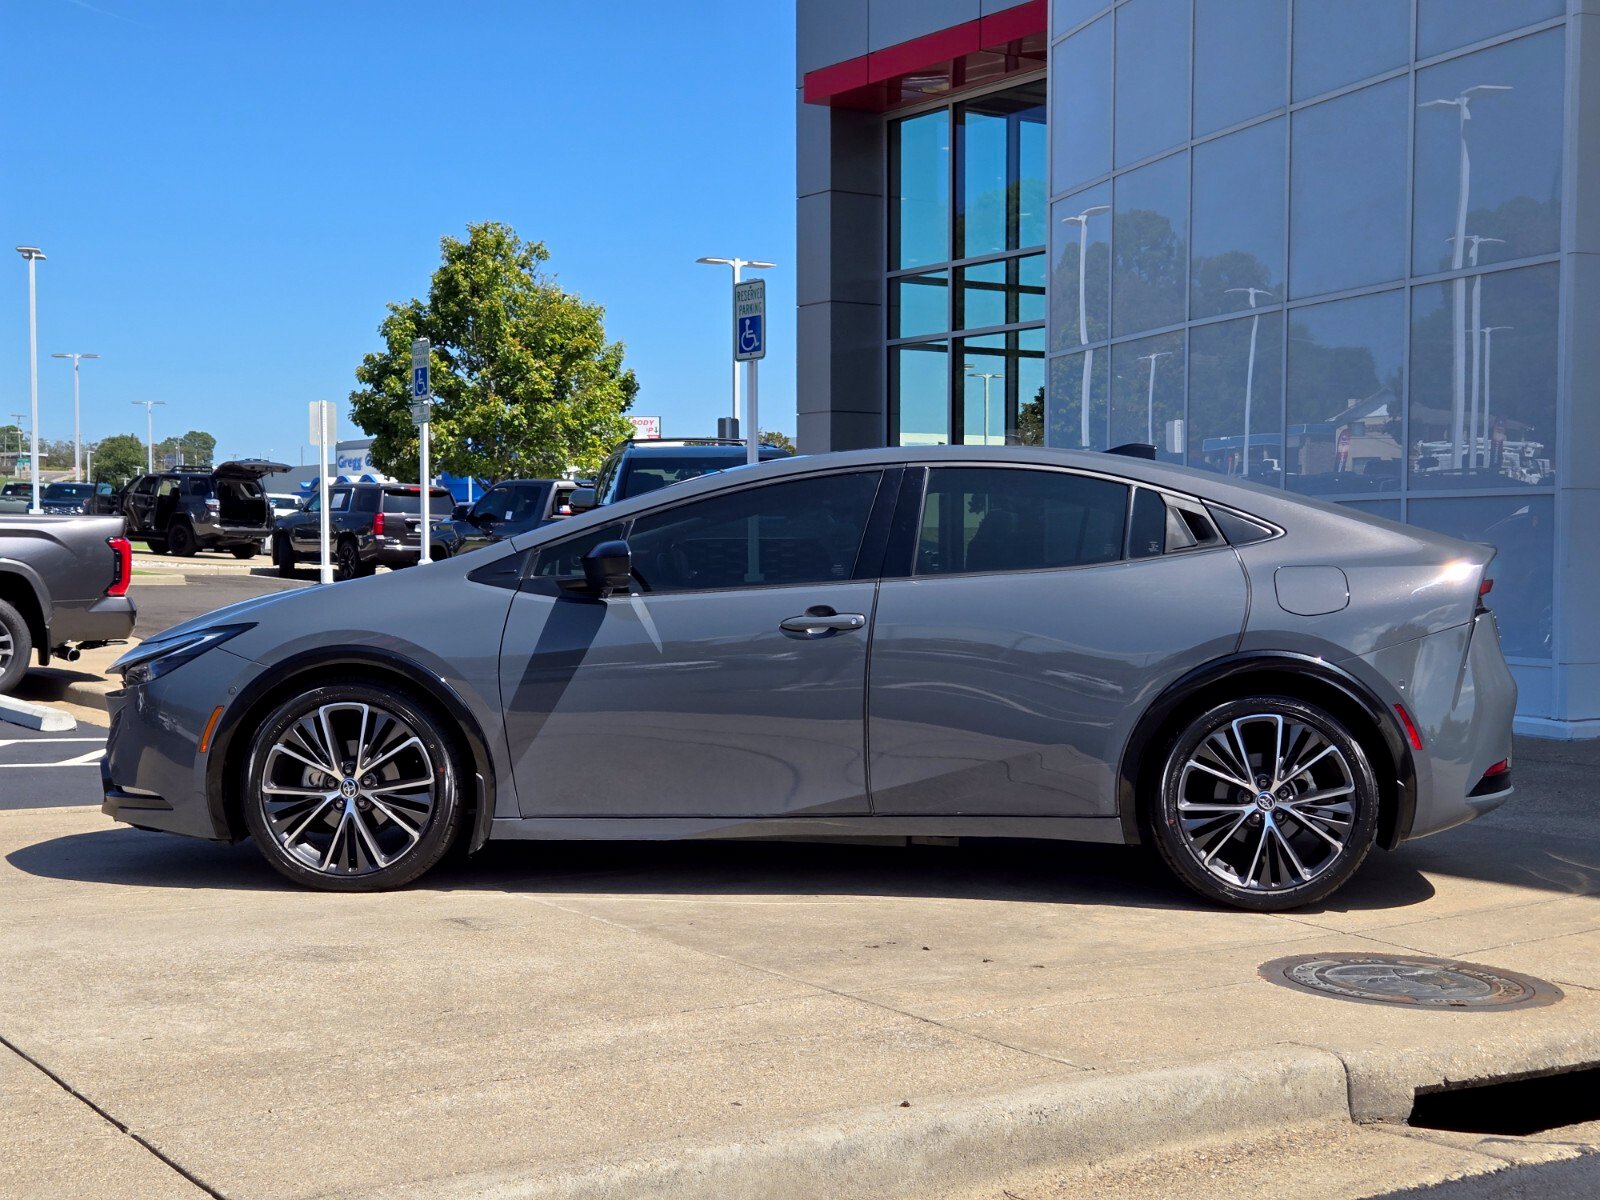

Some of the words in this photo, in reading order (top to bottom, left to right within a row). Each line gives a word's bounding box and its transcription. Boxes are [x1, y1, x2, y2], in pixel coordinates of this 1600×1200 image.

[737, 287, 763, 302] RESERVED
[739, 302, 762, 315] PARKING
[338, 455, 362, 471] Gregg
